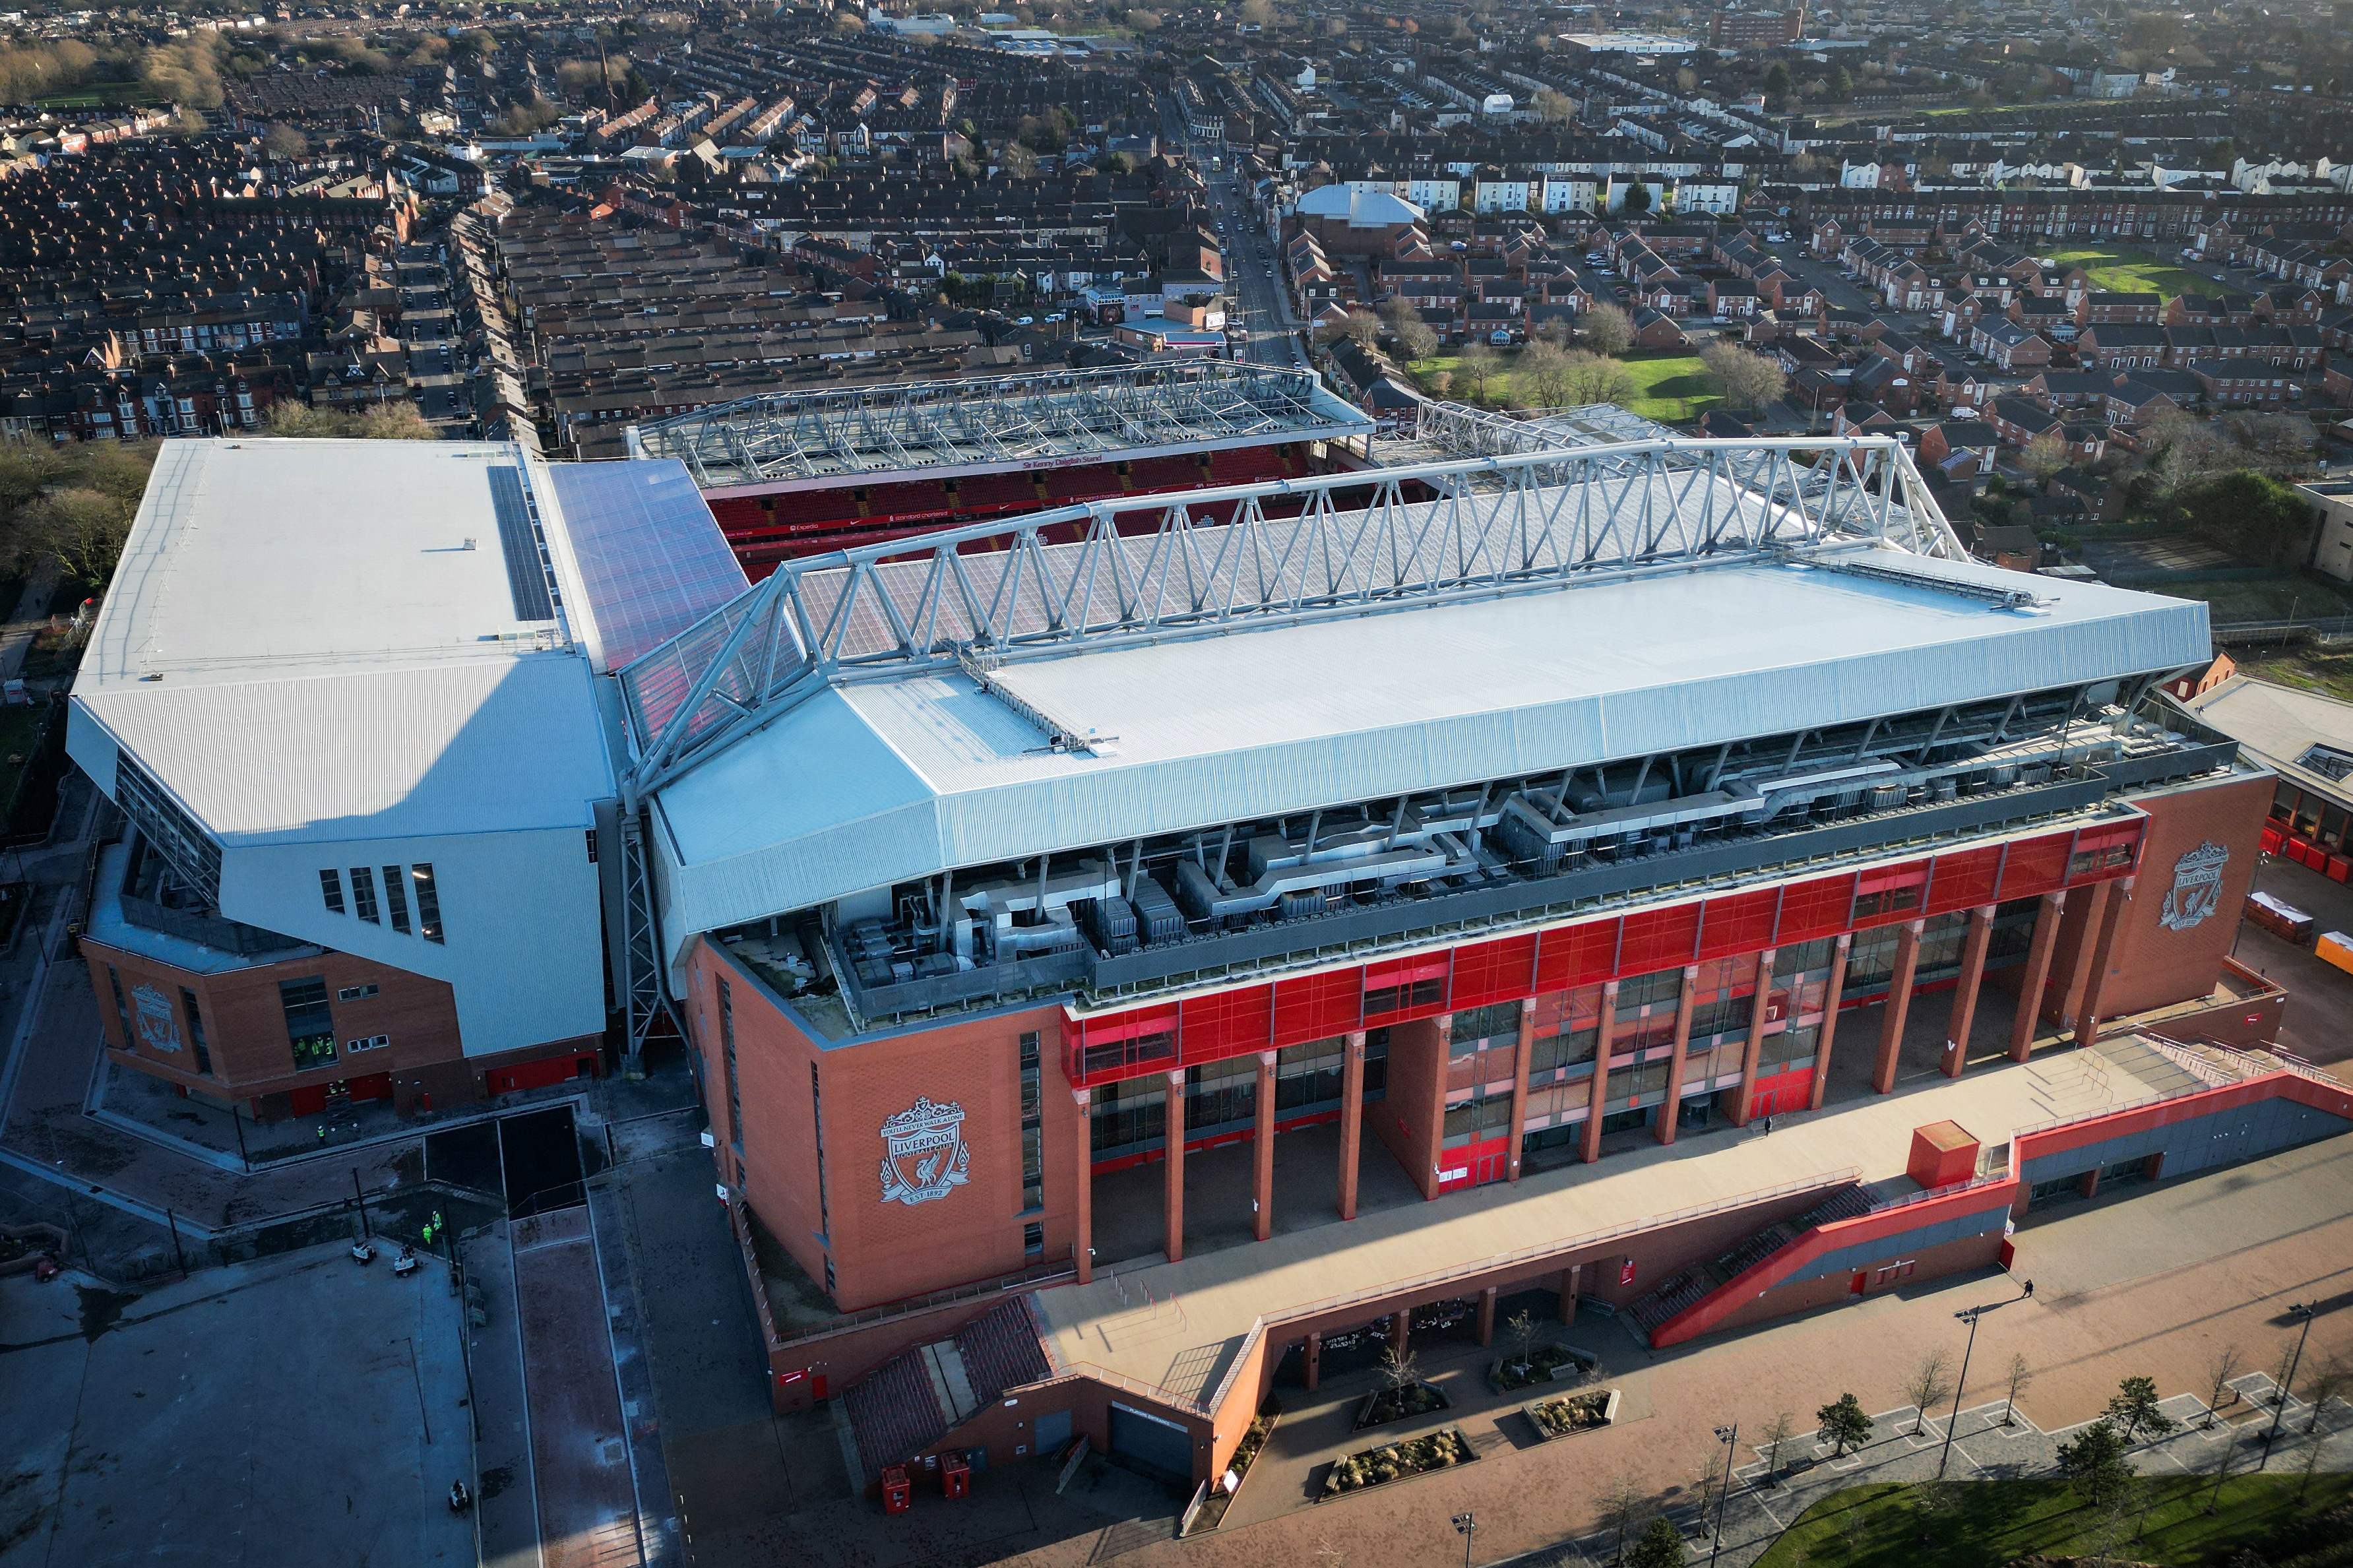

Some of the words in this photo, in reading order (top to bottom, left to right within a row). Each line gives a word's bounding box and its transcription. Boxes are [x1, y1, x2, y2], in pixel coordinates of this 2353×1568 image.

[2179, 871, 2216, 885] LIVERPOOL
[883, 1127, 904, 1135] YOU'LL
[904, 1122, 924, 1131] NEVER
[924, 1118, 942, 1127] WALK
[942, 1113, 963, 1123] ALONE
[894, 1132, 955, 1153] LIVERPOOL
[896, 1148, 932, 1158] FOOTBALL
[934, 1143, 953, 1152] CLUB
